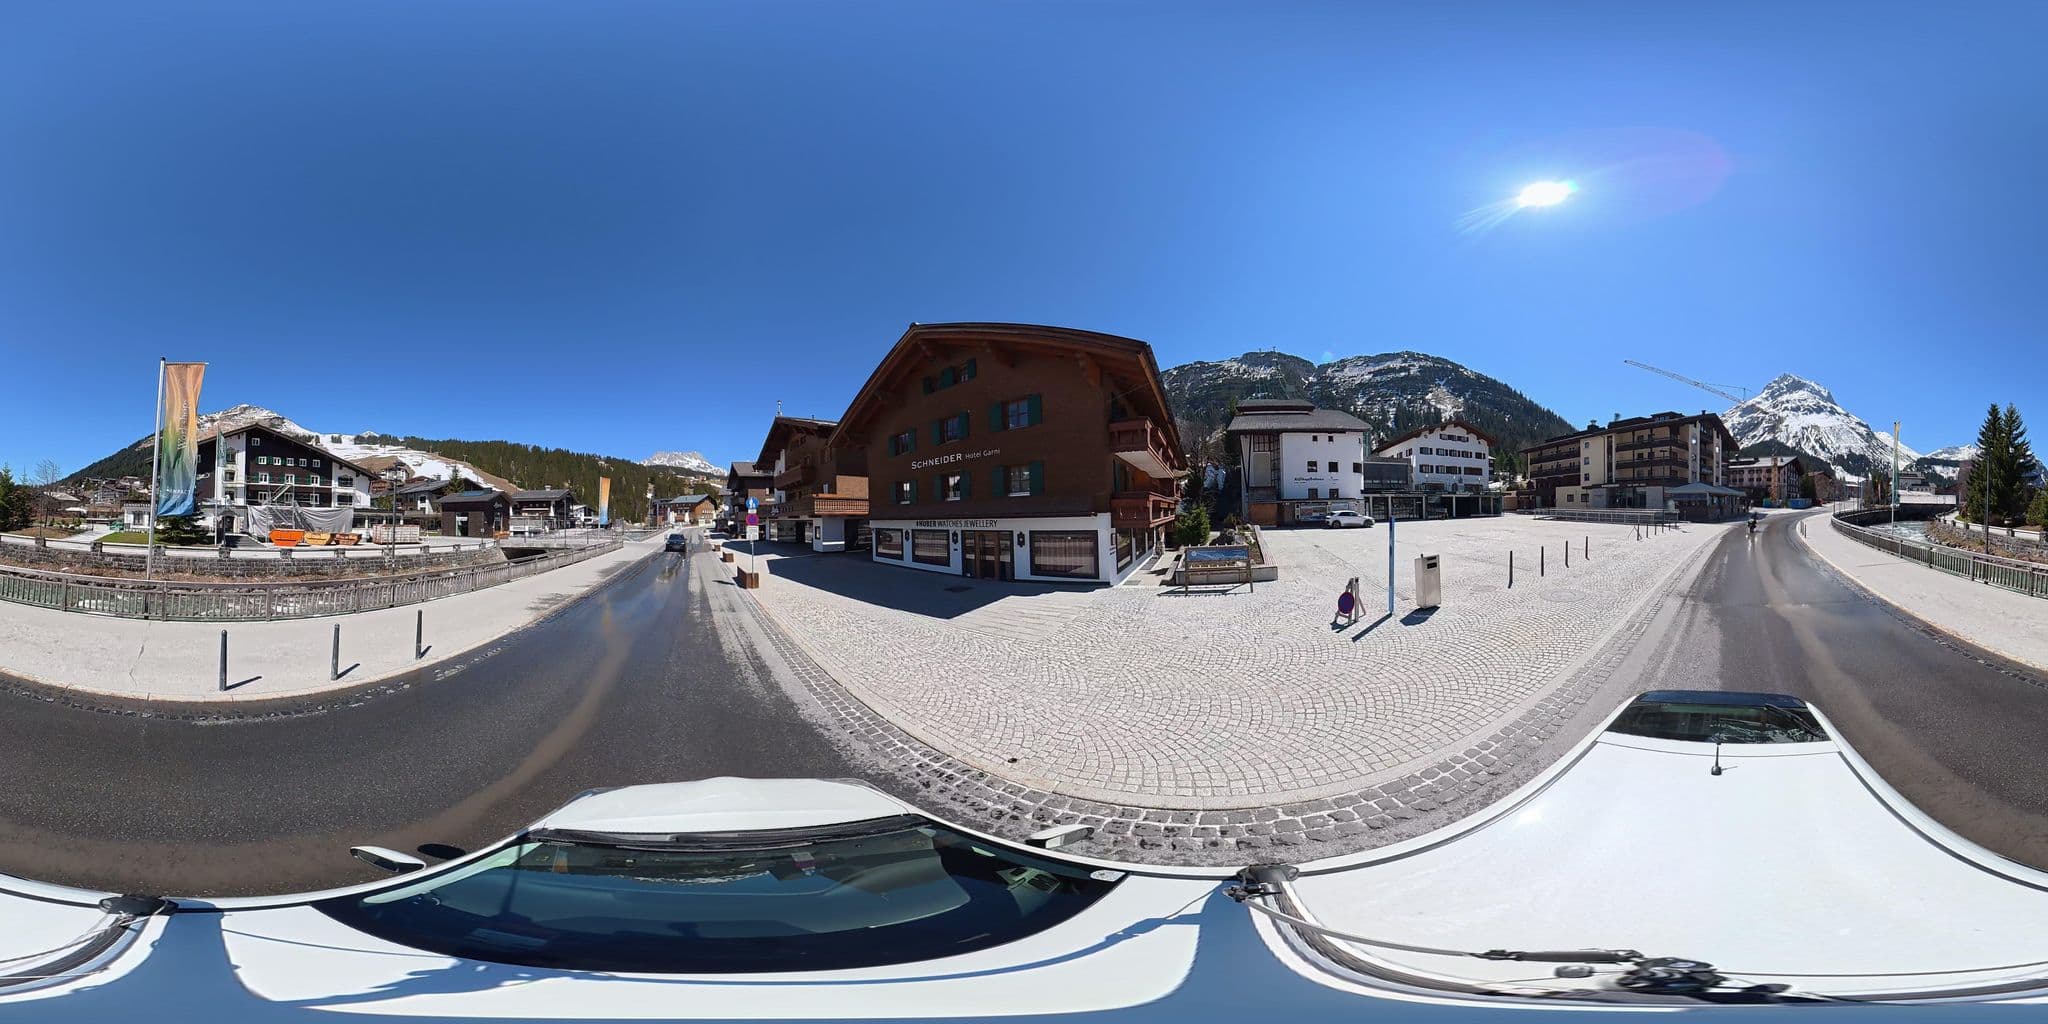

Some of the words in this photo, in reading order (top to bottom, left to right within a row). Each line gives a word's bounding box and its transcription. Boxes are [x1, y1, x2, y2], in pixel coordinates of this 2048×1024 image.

[911, 453, 962, 470] SCHNEIDER
[965, 451, 981, 459] Hotel
[983, 449, 1001, 457] Garni
[937, 520, 963, 528] WATCHES
[964, 519, 998, 528] JEWELLERY
